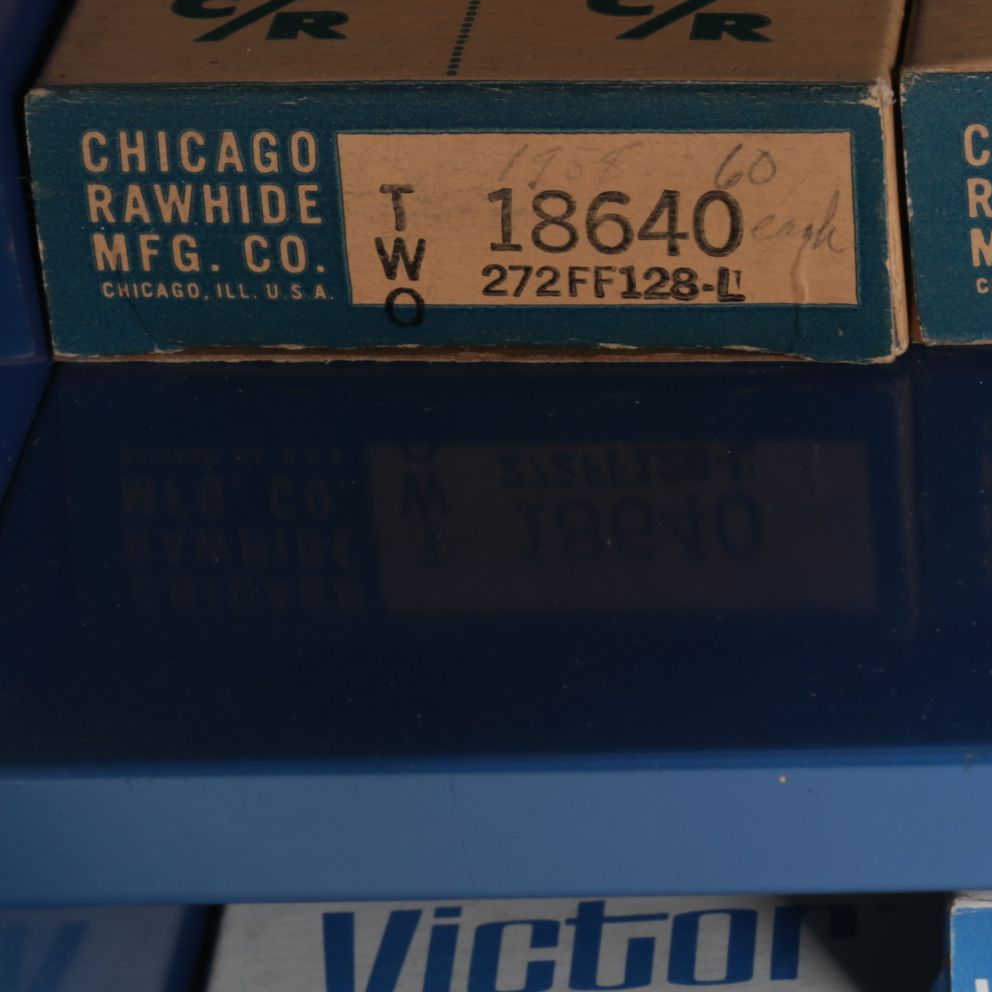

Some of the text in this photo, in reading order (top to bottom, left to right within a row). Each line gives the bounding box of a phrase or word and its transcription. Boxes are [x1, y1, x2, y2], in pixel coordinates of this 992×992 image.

[81, 130, 318, 174] CHICAGO
[86, 183, 322, 225] RAWHIDE
[486, 188, 744, 257] 18640
[92, 233, 326, 273] MFG. CO.
[376, 183, 426, 328] TWO
[103, 281, 208, 300] CHICAGO,
[322, 900, 857, 992] Victor
